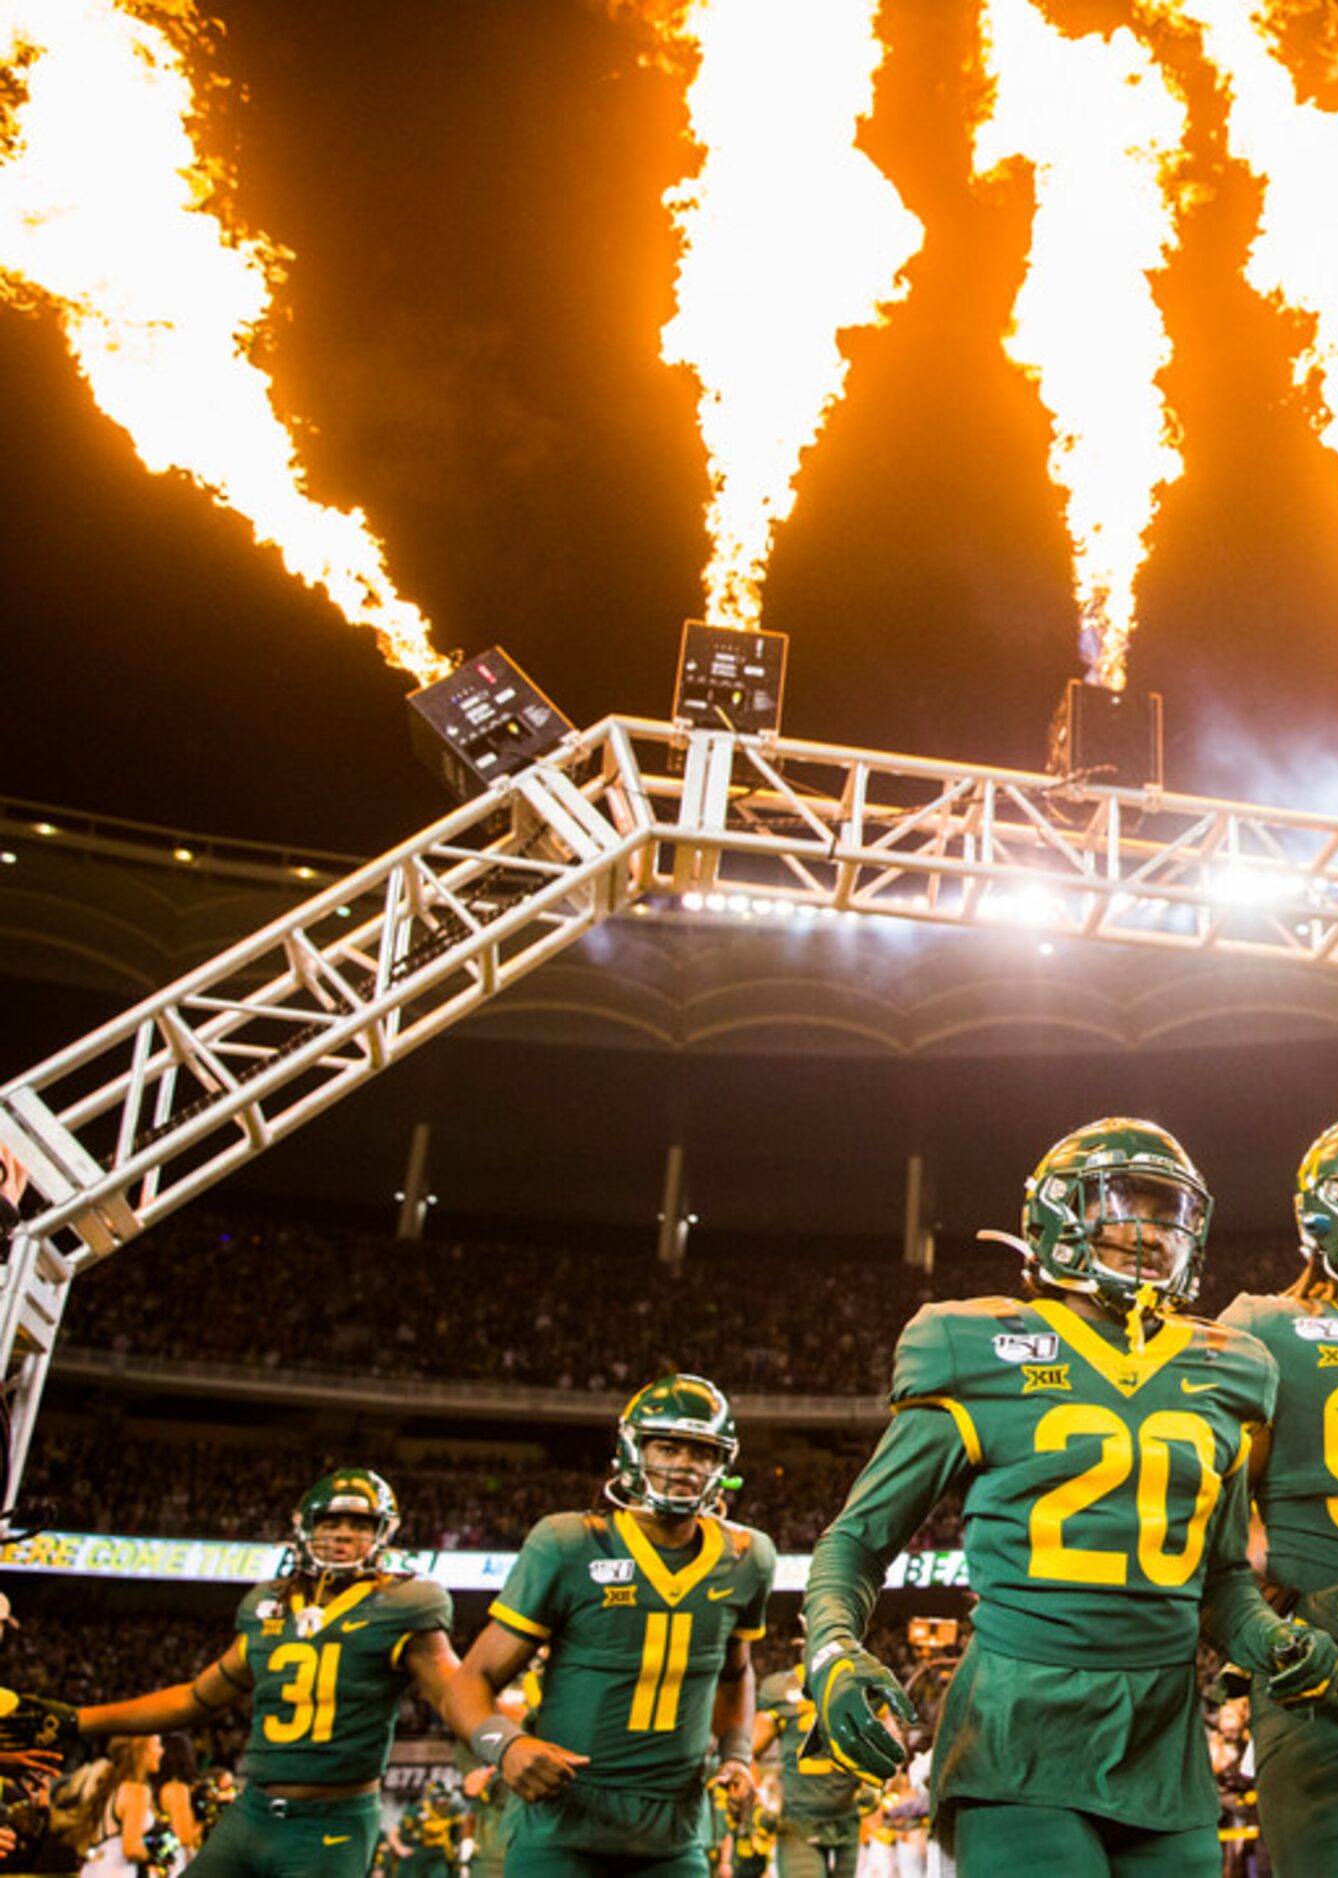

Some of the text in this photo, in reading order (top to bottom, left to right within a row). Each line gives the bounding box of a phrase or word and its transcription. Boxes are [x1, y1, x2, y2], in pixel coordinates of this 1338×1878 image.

[1027, 1402, 1223, 1588] 20
[200, 1544, 267, 1577] THE
[262, 1641, 342, 1744] 31
[626, 1612, 694, 1732] 11
